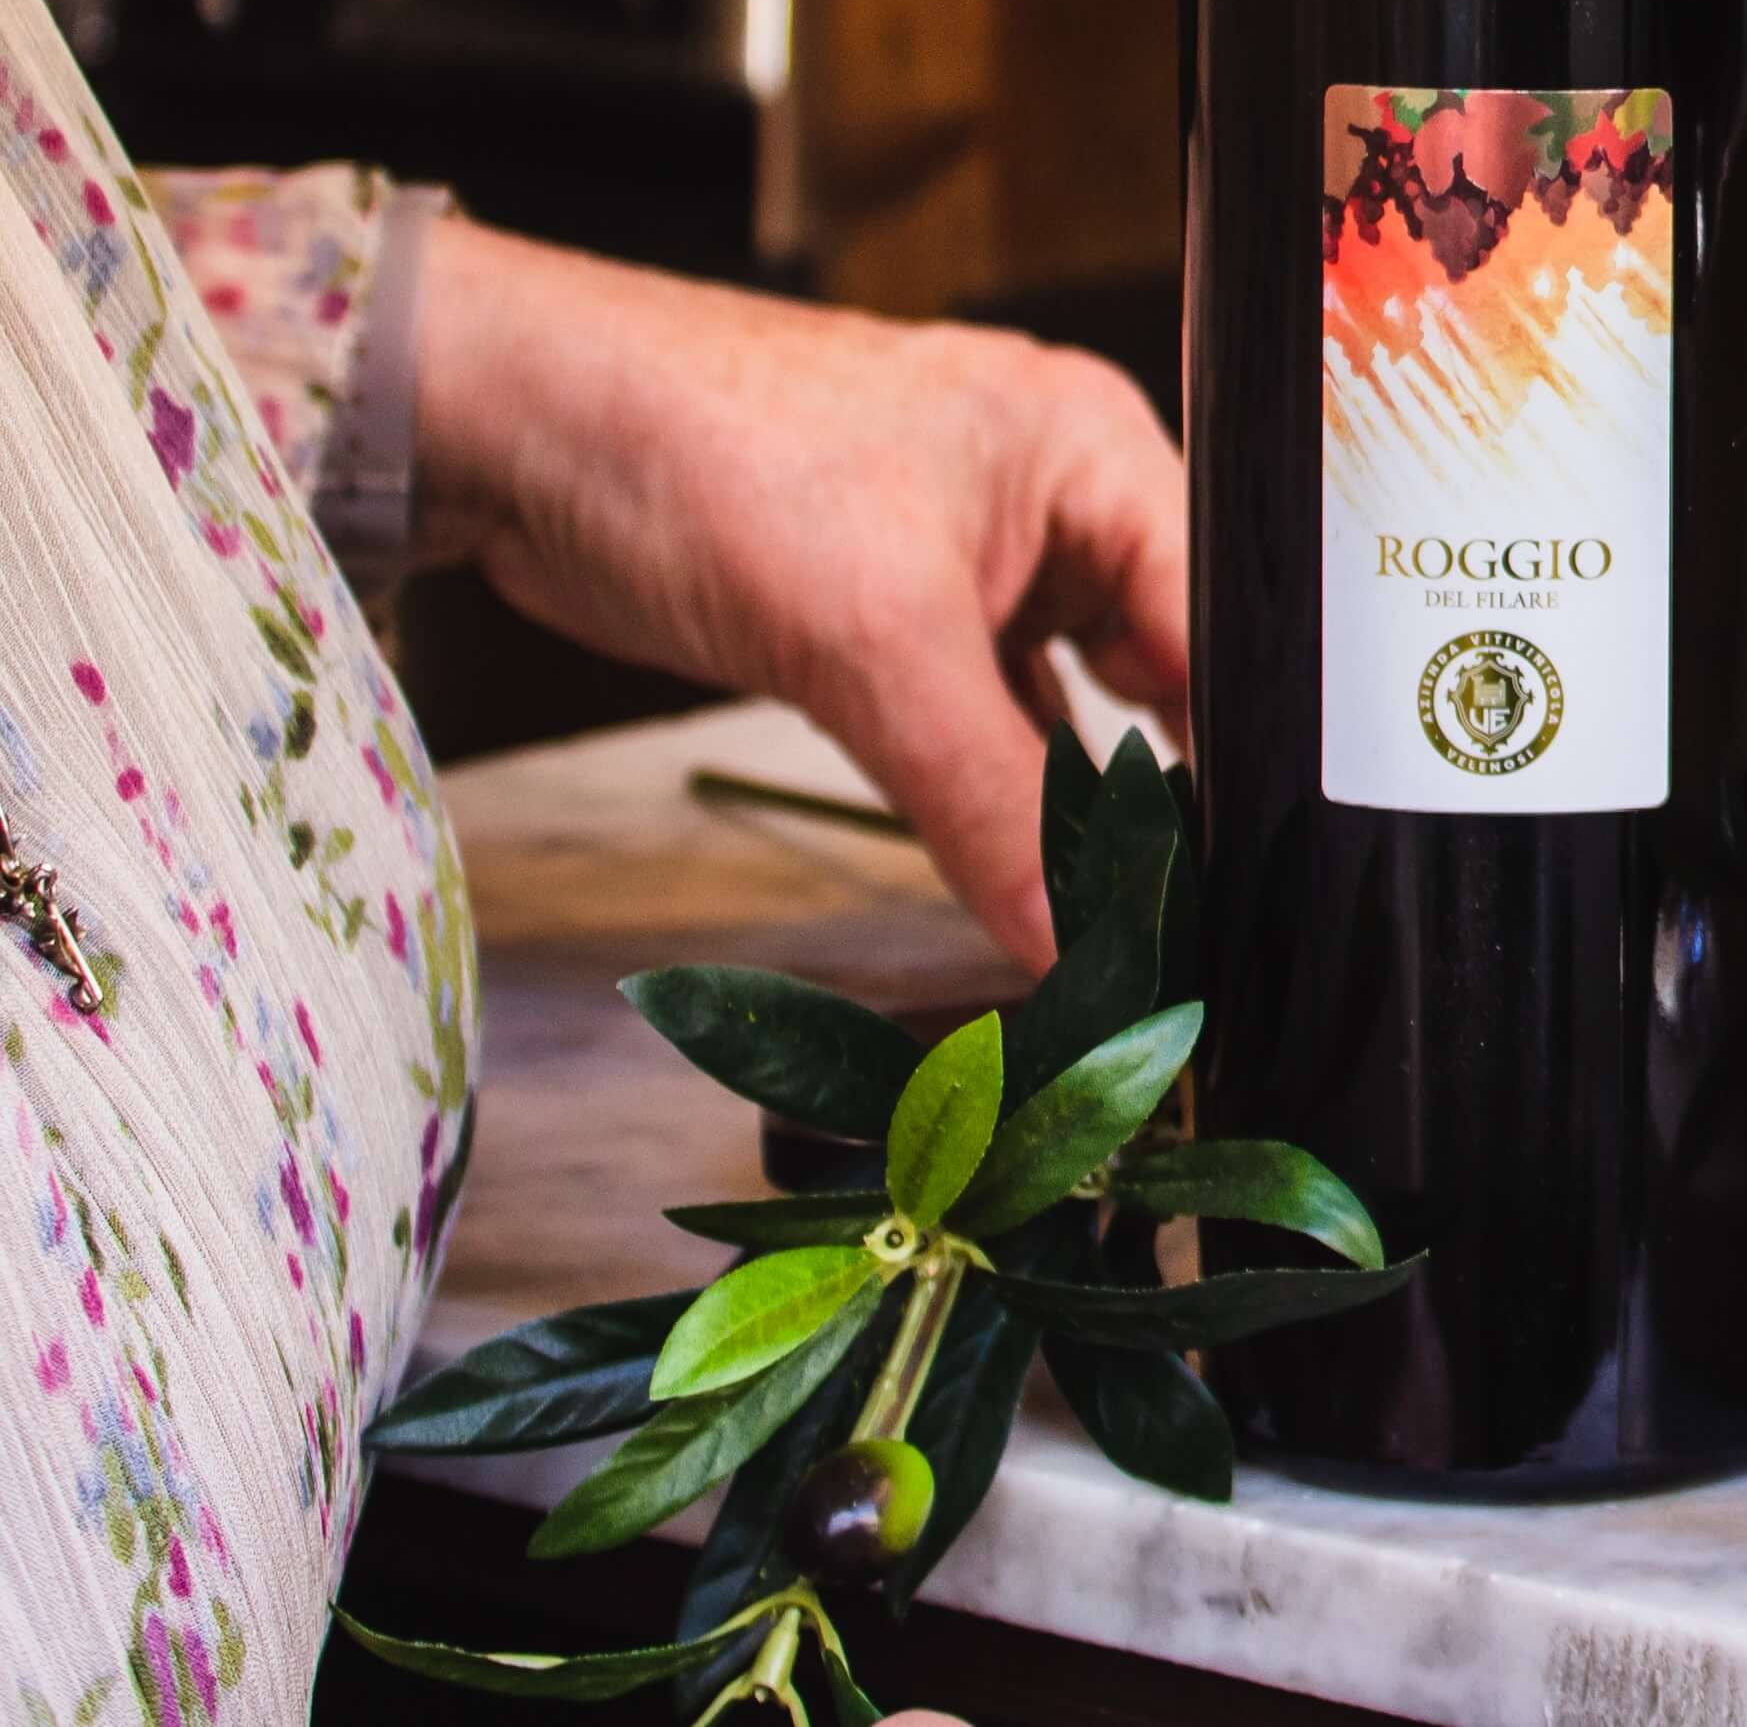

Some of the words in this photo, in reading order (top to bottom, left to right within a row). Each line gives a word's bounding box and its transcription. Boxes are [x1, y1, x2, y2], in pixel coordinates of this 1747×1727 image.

[1374, 533, 1612, 581] ROGGIO
[1425, 589, 1469, 608] DEL
[1476, 590, 1561, 610] FILARE
[1419, 643, 1460, 723] AZIENDA
[1470, 633, 1561, 724] VITIVINICOLA
[1447, 747, 1535, 772] VELENOSI
